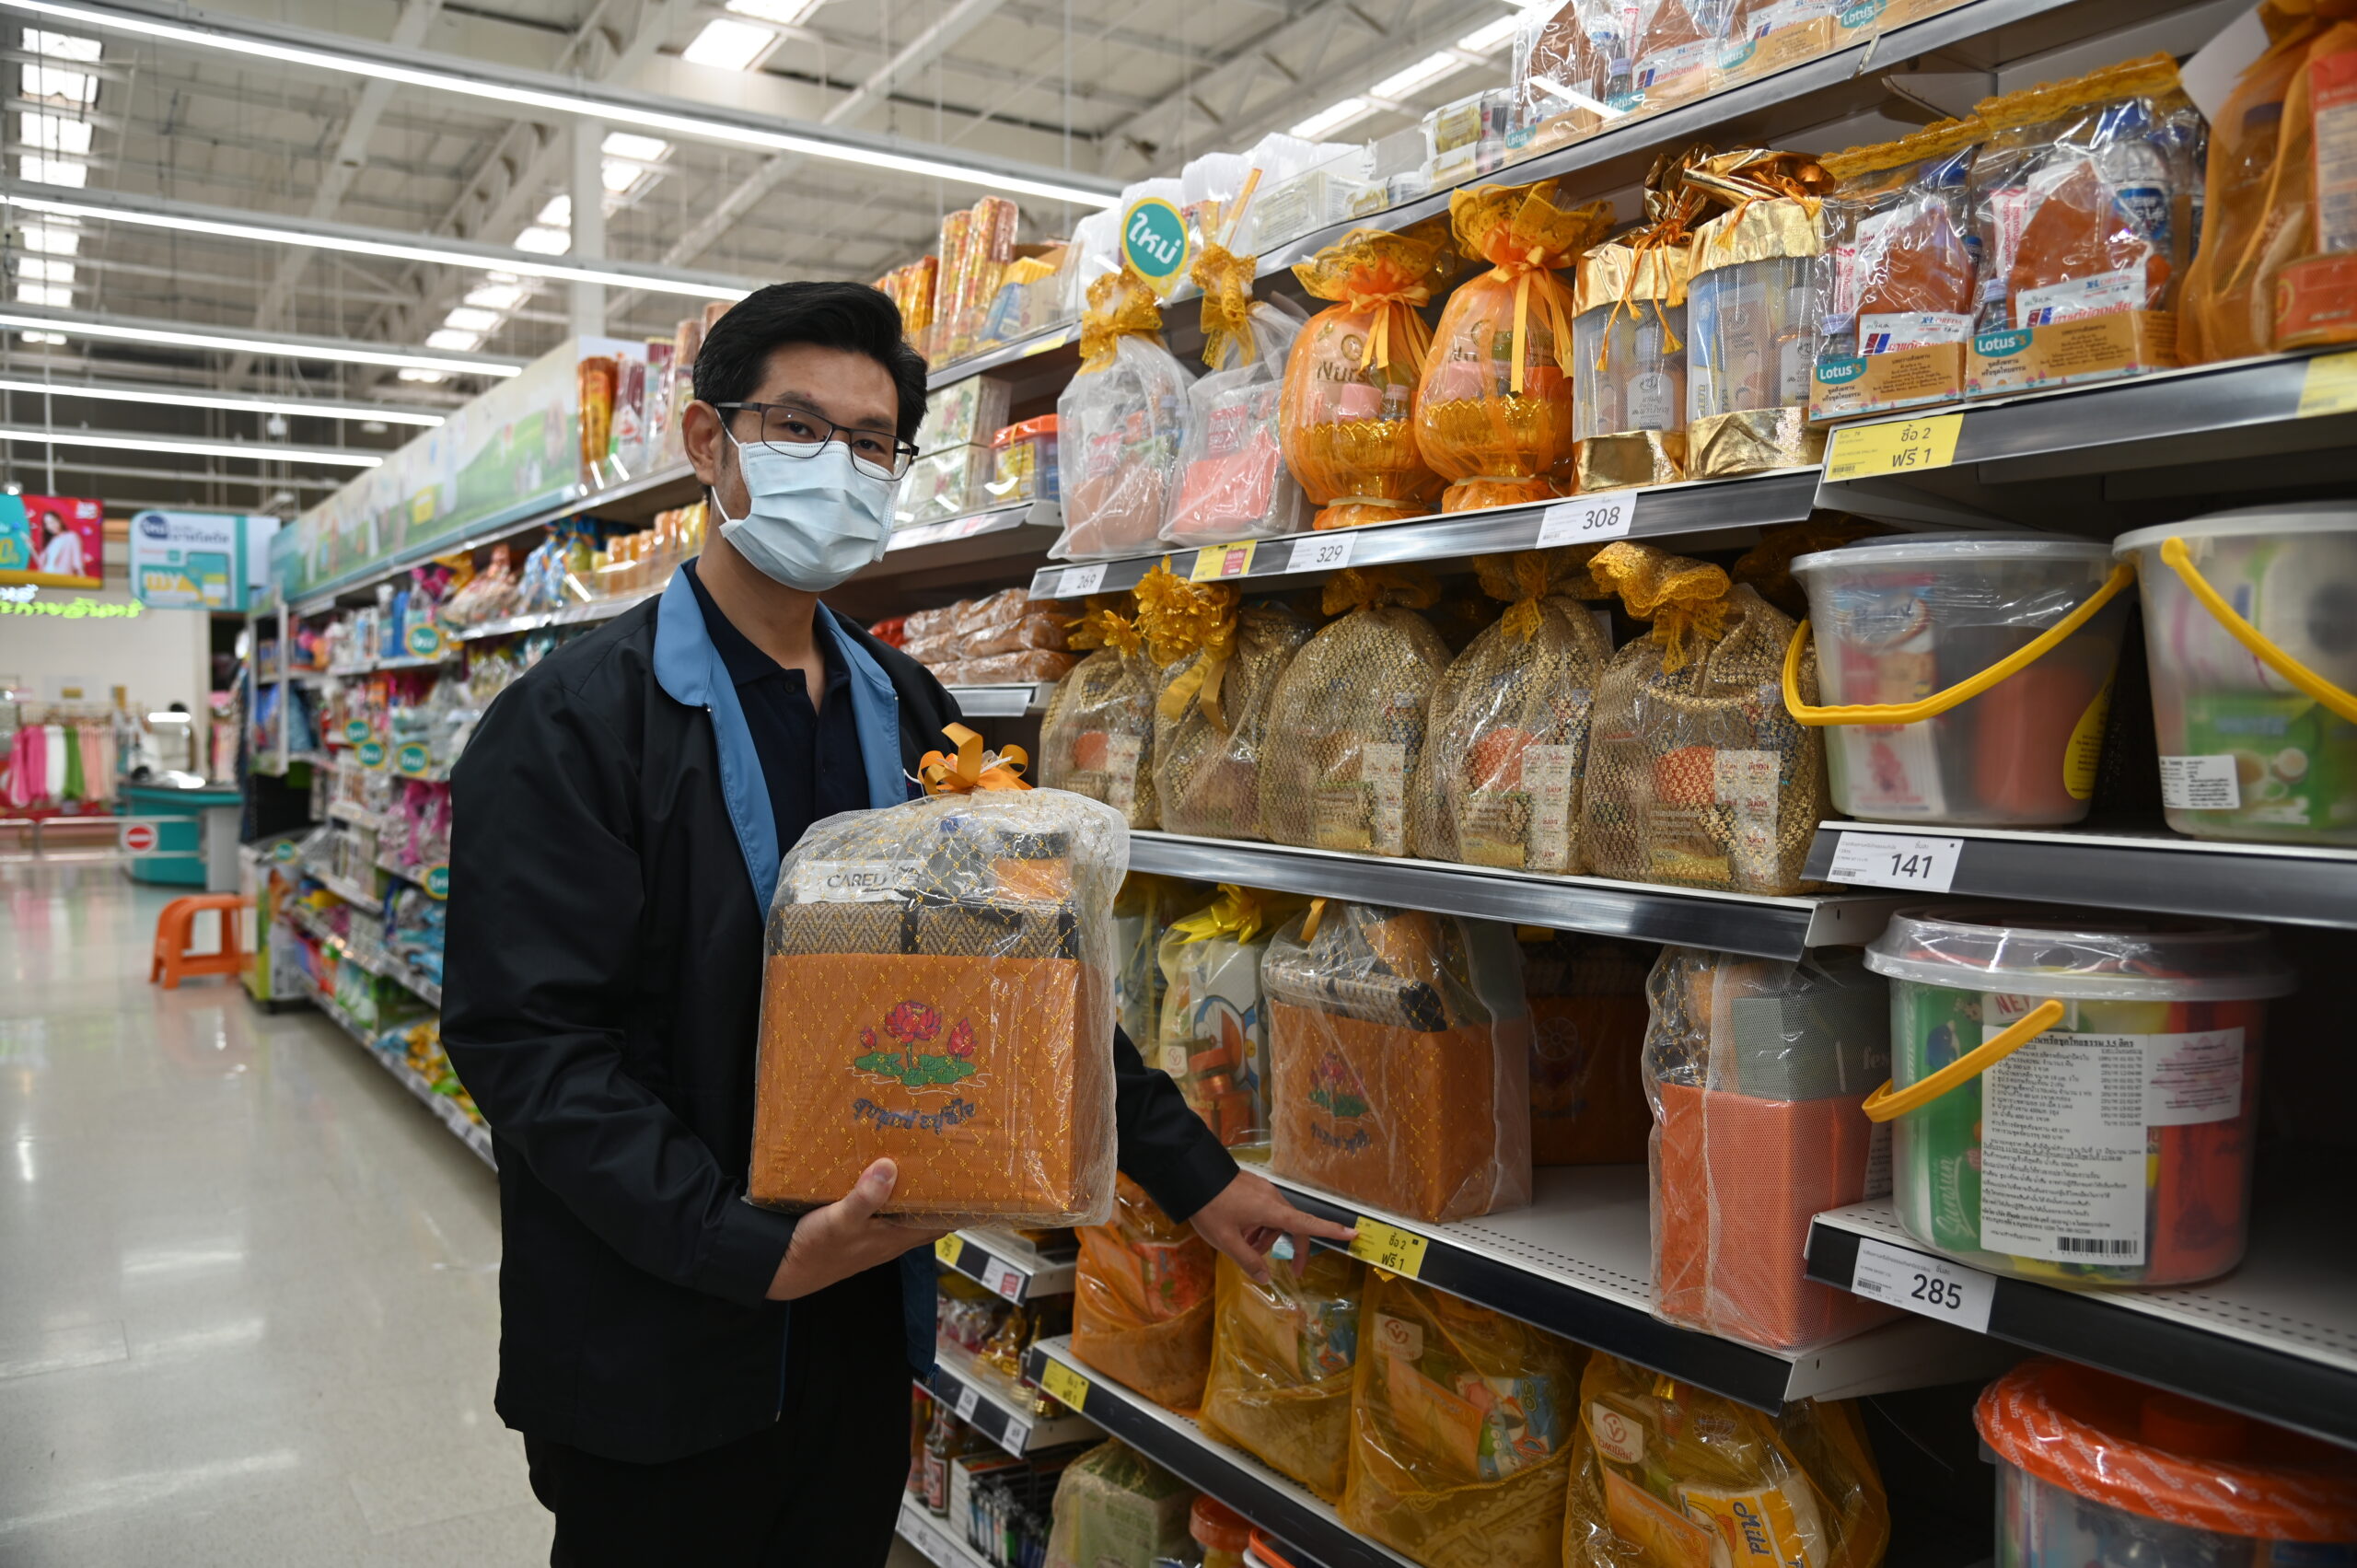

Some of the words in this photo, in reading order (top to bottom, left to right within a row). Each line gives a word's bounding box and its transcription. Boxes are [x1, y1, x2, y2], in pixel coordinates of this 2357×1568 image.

[1129, 212, 1181, 264] ใหม่
[1901, 424, 1918, 442] ซื้อ
[1922, 427, 1931, 439] 2
[1892, 447, 1918, 468] ฟรี
[1924, 448, 1932, 463] 1
[1582, 505, 1620, 529] 308
[1317, 544, 1343, 563] 329
[1076, 574, 1097, 590] 269
[1891, 854, 1933, 878] 141
[1995, 993, 2030, 1015] NE
[1400, 1240, 1407, 1249] 2
[1381, 1252, 1398, 1268] ฟรี
[1399, 1258, 1404, 1271] 1
[1911, 1273, 1963, 1309] 285
[1732, 1501, 1771, 1555] Mild
